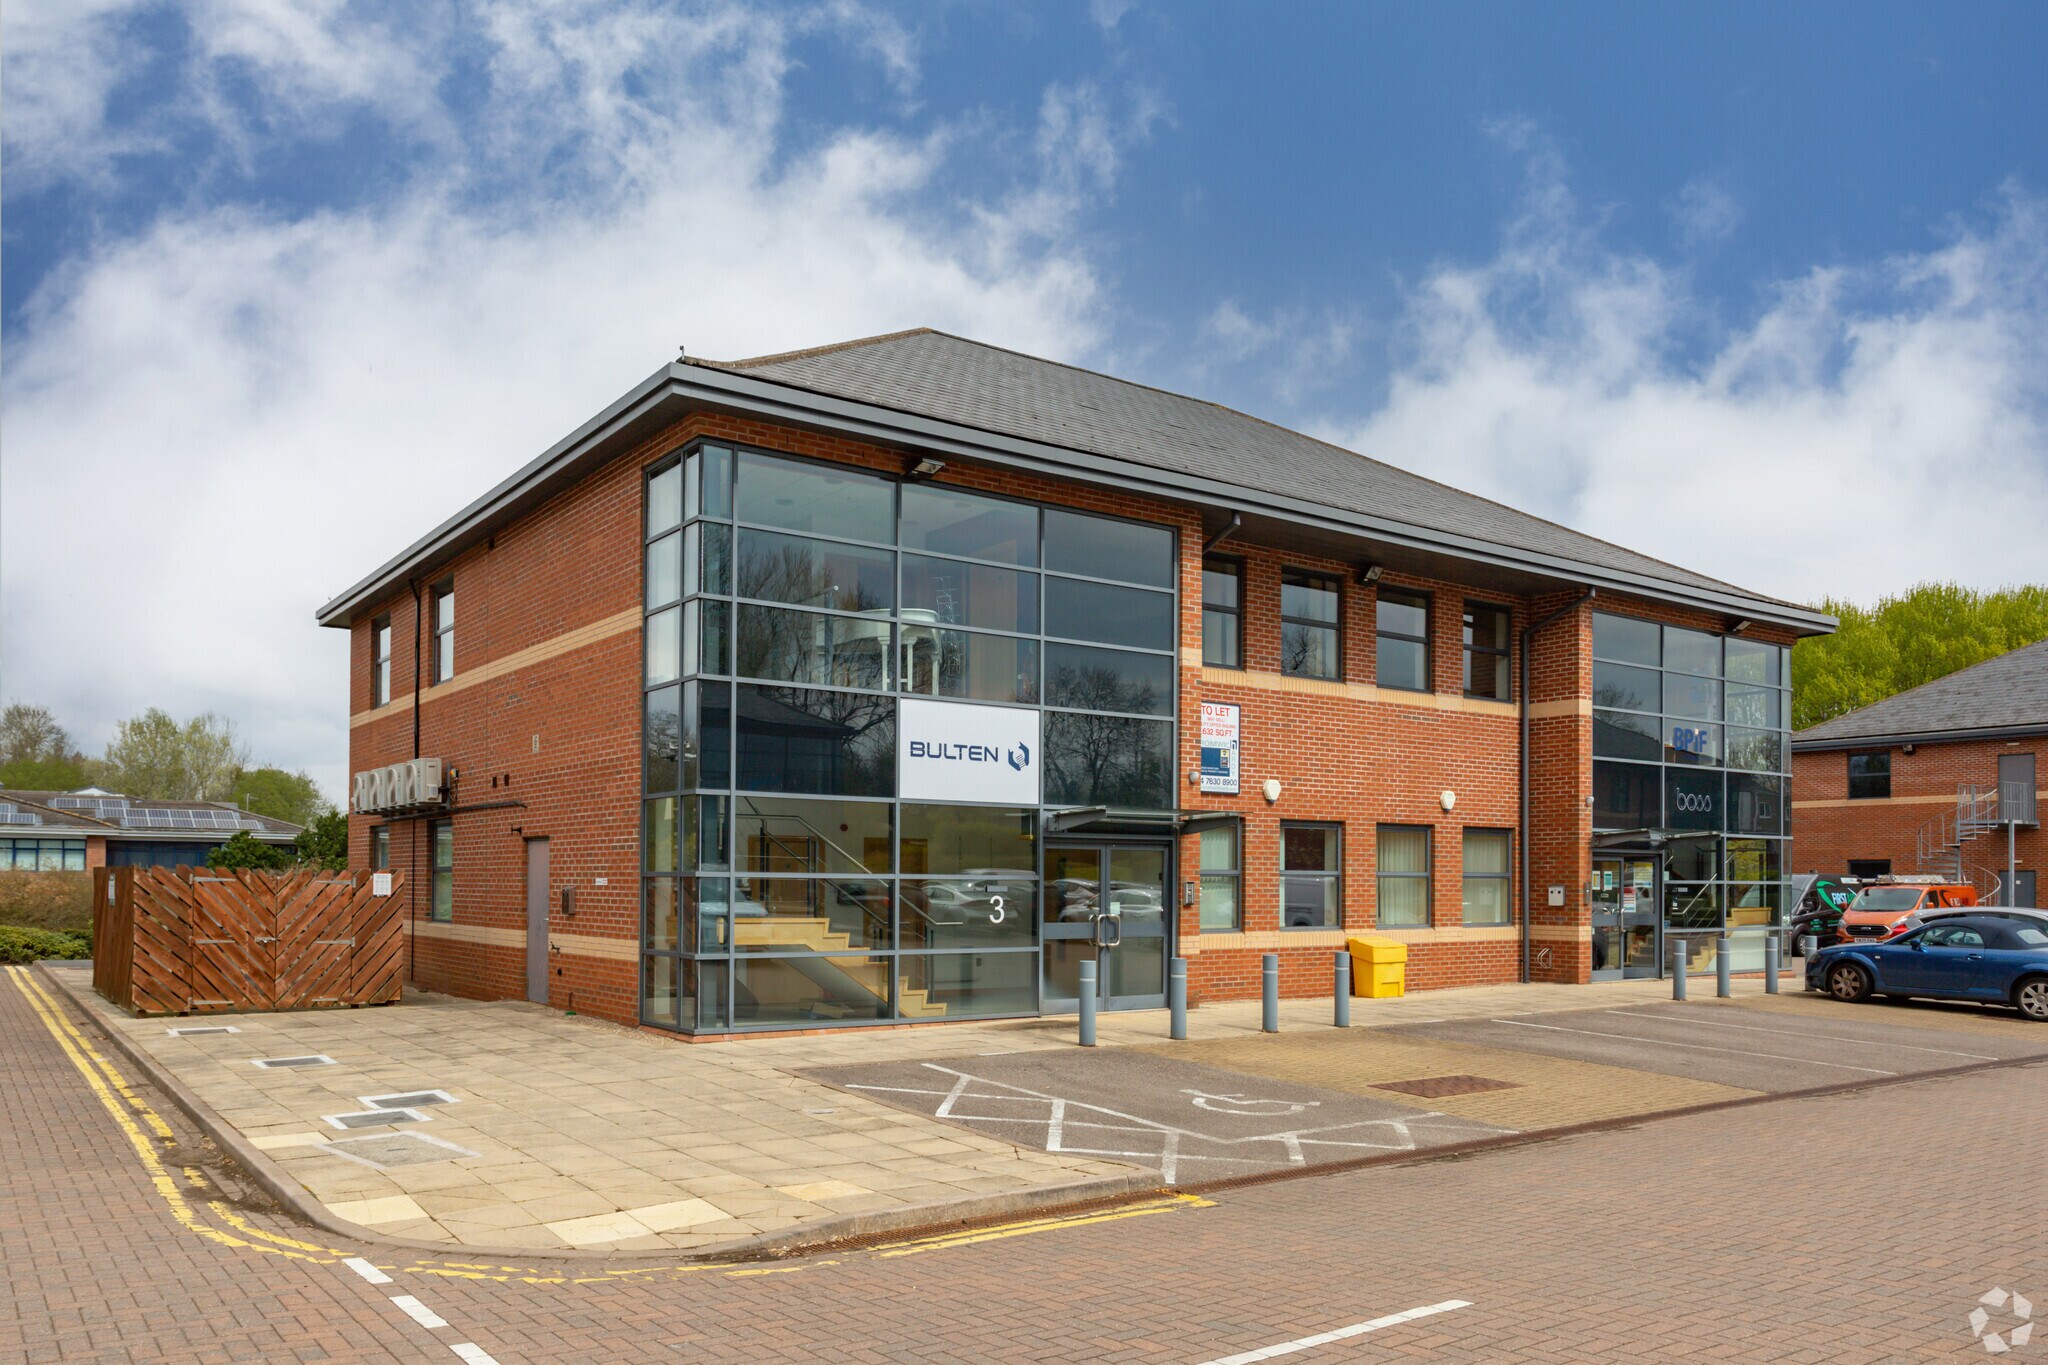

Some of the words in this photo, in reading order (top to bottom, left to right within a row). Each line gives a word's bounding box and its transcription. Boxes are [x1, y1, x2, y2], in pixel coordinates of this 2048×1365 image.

[1201, 706, 1212, 715] TO
[1215, 707, 1230, 716] LET
[910, 740, 998, 762] BULTEN
[1676, 787, 1712, 812] boss
[989, 895, 1005, 924] 3
